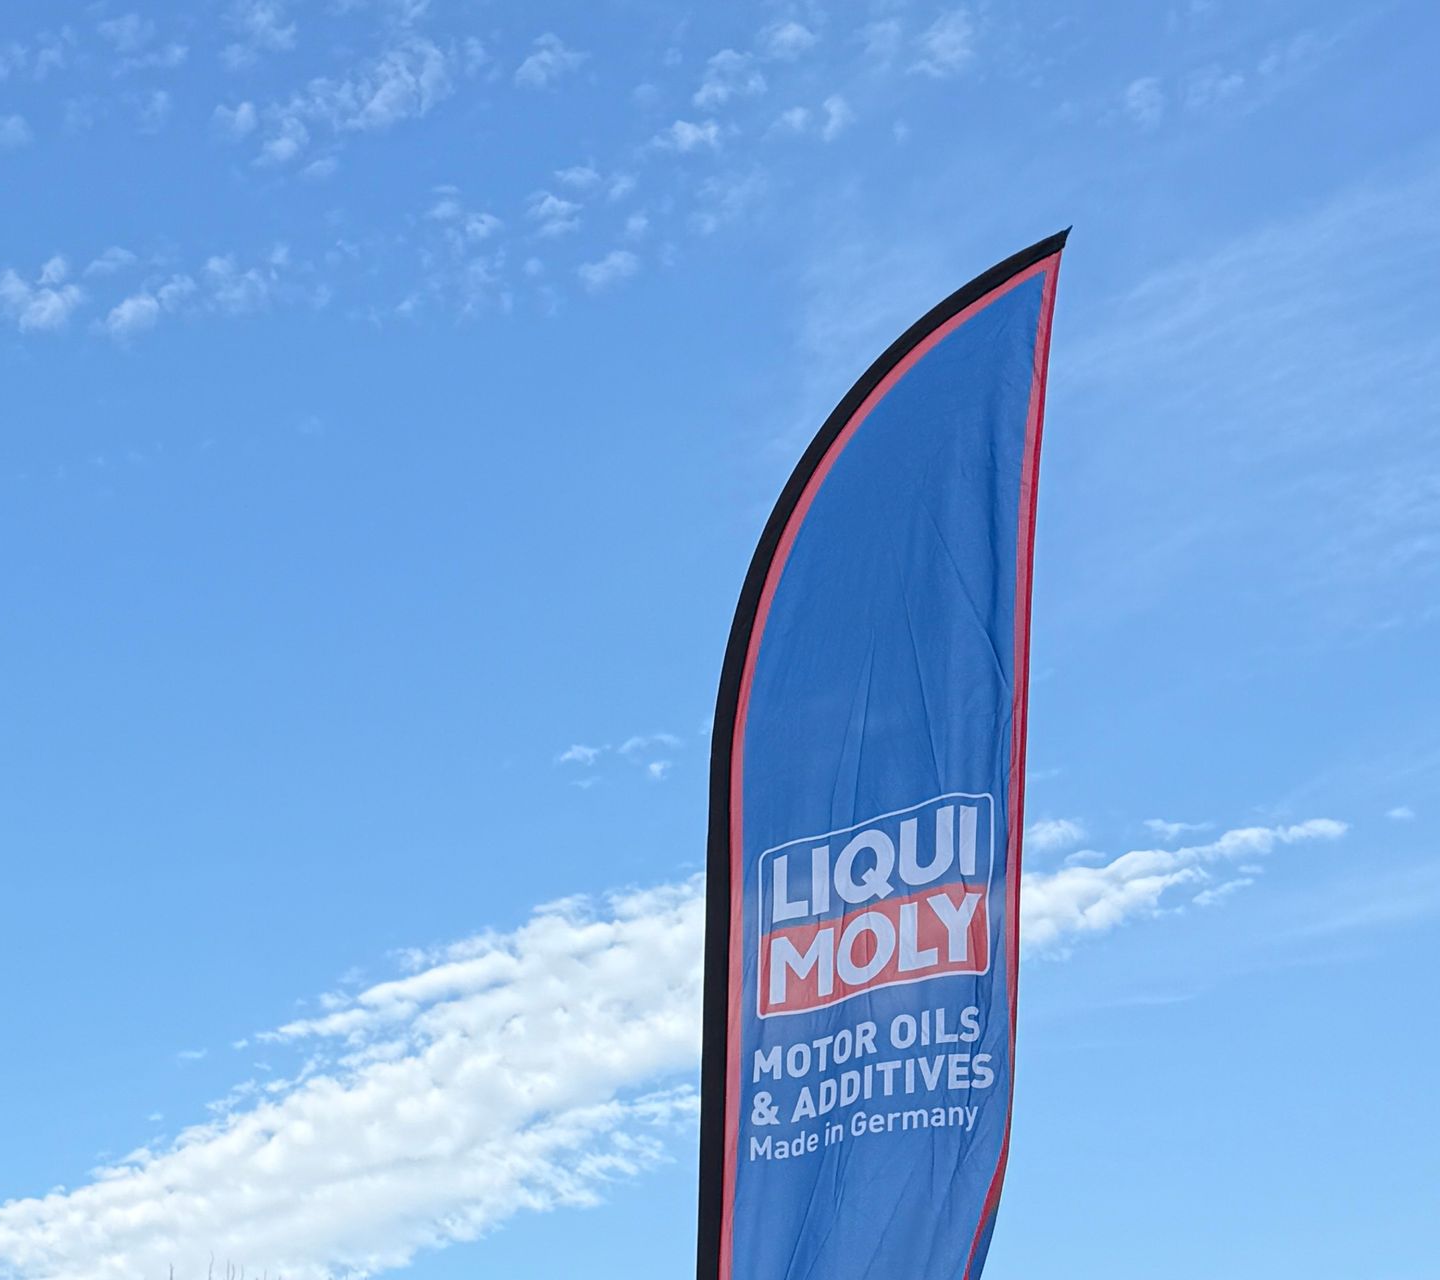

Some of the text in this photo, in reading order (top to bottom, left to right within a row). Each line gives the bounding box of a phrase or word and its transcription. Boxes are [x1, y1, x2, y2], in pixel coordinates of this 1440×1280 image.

[772, 804, 978, 923] LIQUI
[768, 892, 983, 1006] MOLY
[753, 1006, 980, 1084] MOTOR OILS
[750, 1053, 995, 1127] & ADDITIVES
[750, 1104, 979, 1162] Made in Germany
